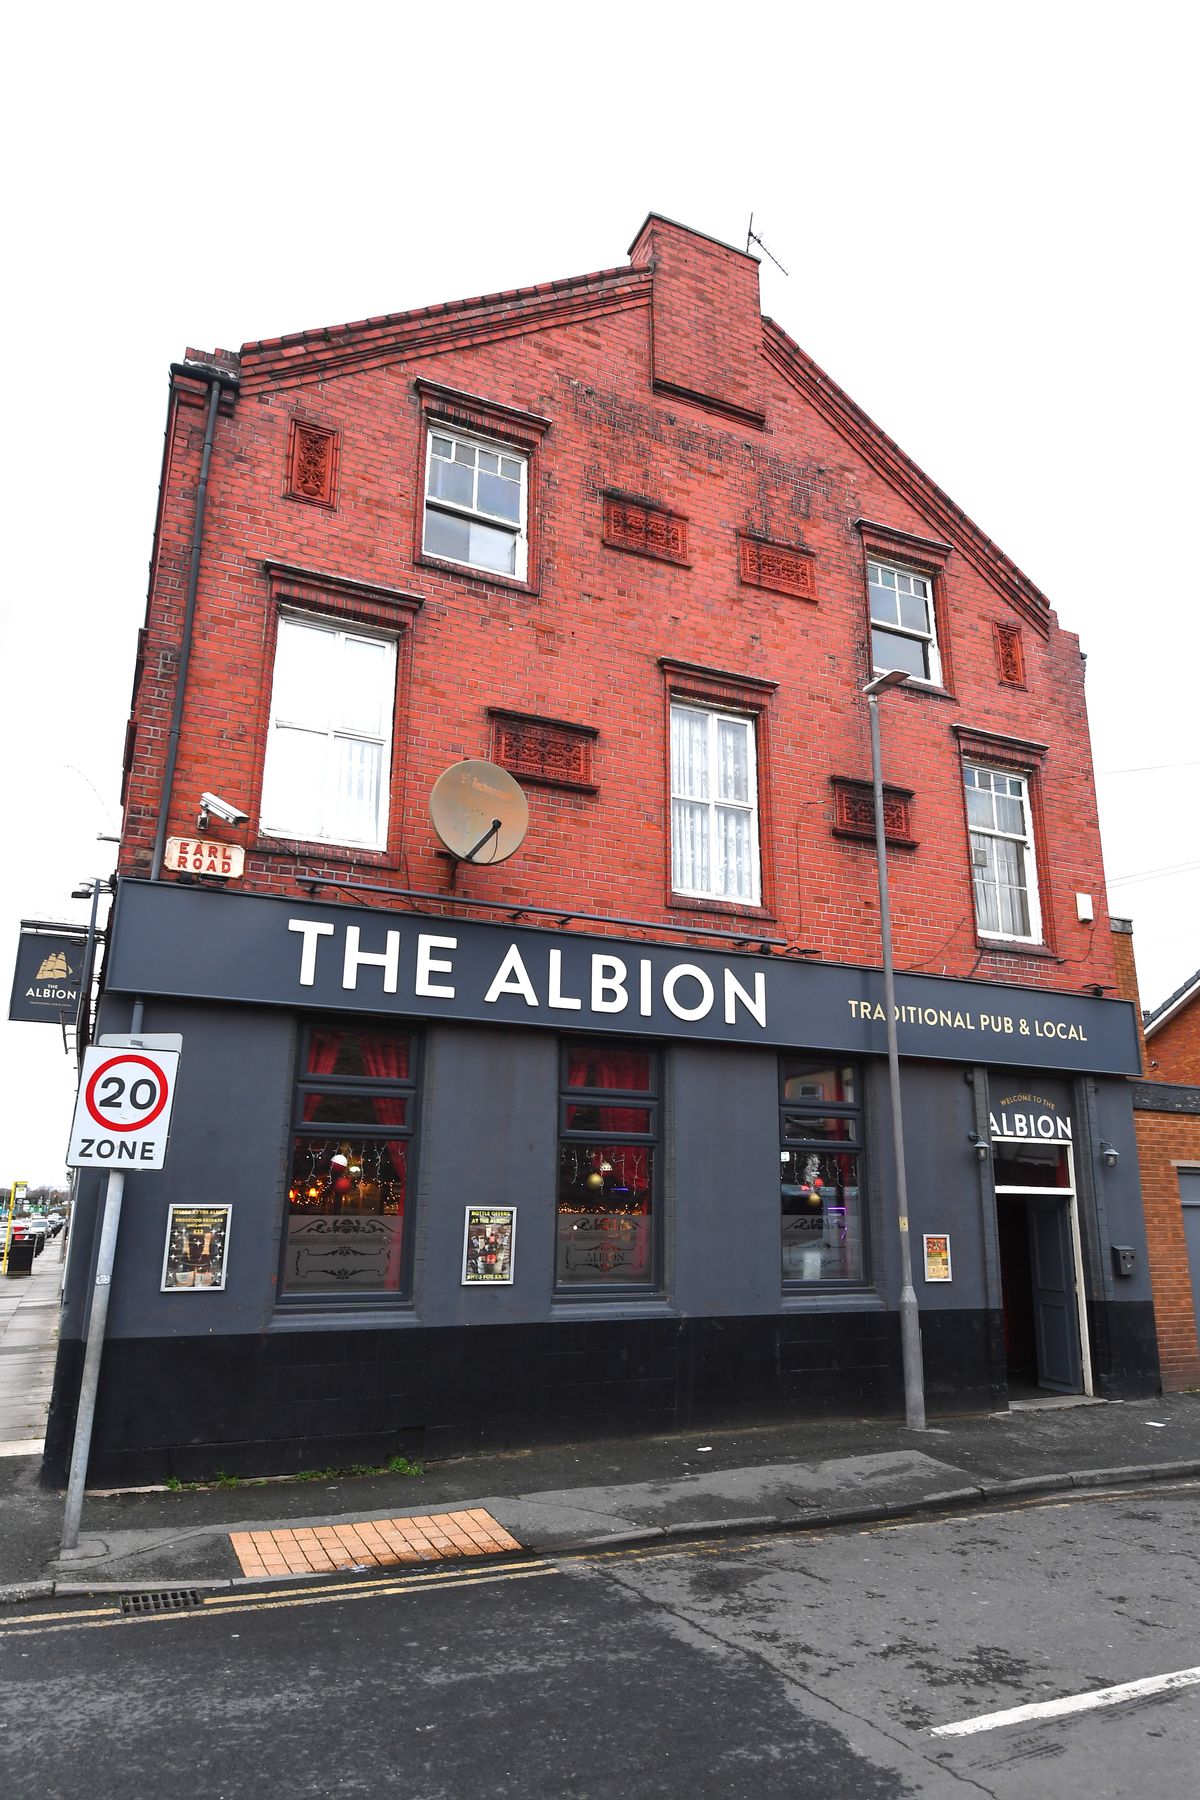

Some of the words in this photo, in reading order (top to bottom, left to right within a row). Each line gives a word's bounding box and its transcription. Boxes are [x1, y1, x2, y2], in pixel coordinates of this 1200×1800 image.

[179, 842, 231, 860] EARL
[177, 856, 231, 873] ROAD
[288, 918, 458, 999] THE
[484, 943, 767, 1028] ALBION
[26, 988, 77, 1000] ALBION
[980, 1014, 1014, 1034] PUB
[1019, 1018, 1031, 1036] &
[1035, 1020, 1088, 1042] LOCAL
[99, 1077, 157, 1110] 20
[1000, 1094, 1032, 1106] WELCOME
[1032, 1095, 1042, 1104] TO
[1043, 1099, 1056, 1111] THE
[989, 1112, 1072, 1139] ALBION
[78, 1138, 155, 1160] ZONE
[586, 1251, 625, 1262] ALBION
